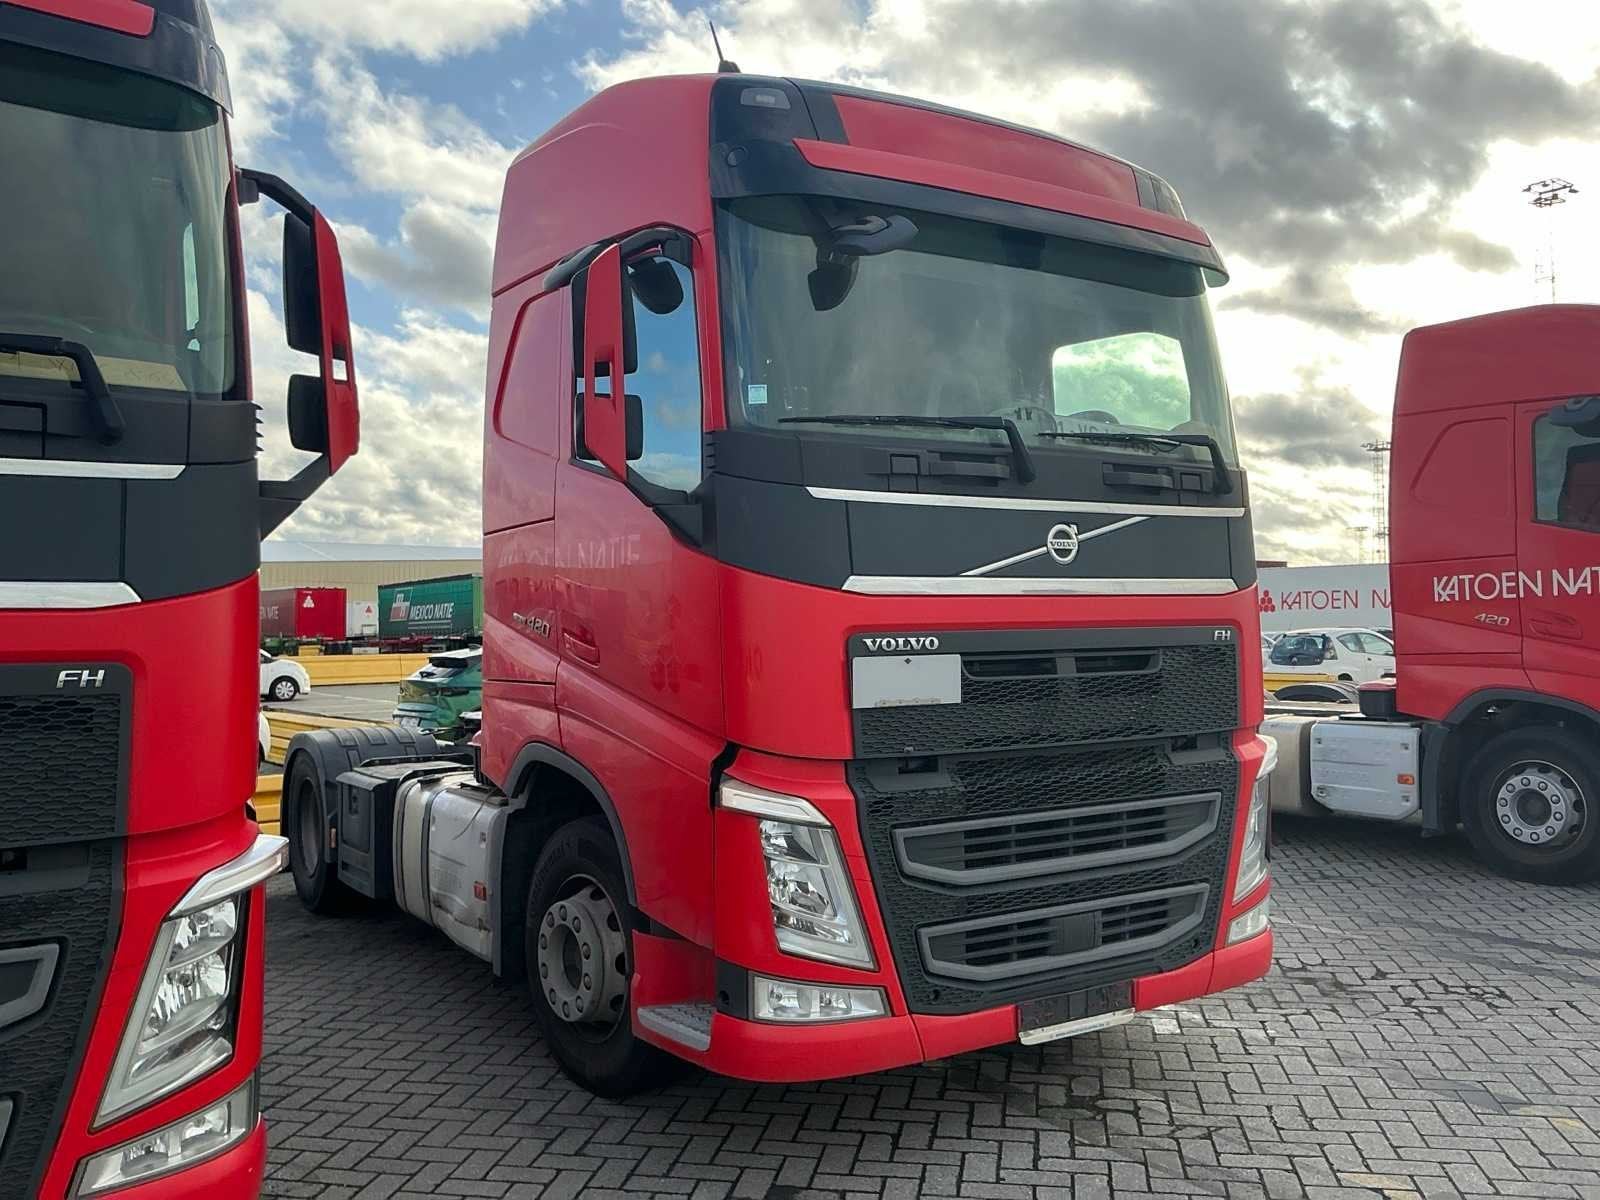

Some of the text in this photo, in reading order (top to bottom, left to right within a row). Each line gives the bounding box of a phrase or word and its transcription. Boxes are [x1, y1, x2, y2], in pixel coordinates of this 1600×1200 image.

[1433, 569, 1543, 602] KATOEN
[1280, 589, 1358, 610] KATOEN
[409, 602, 455, 620] MEXICO NATIE
[1473, 613, 1510, 626] 420
[862, 636, 939, 652] VOLVO
[1214, 630, 1231, 641] FH
[56, 669, 105, 689] FH
